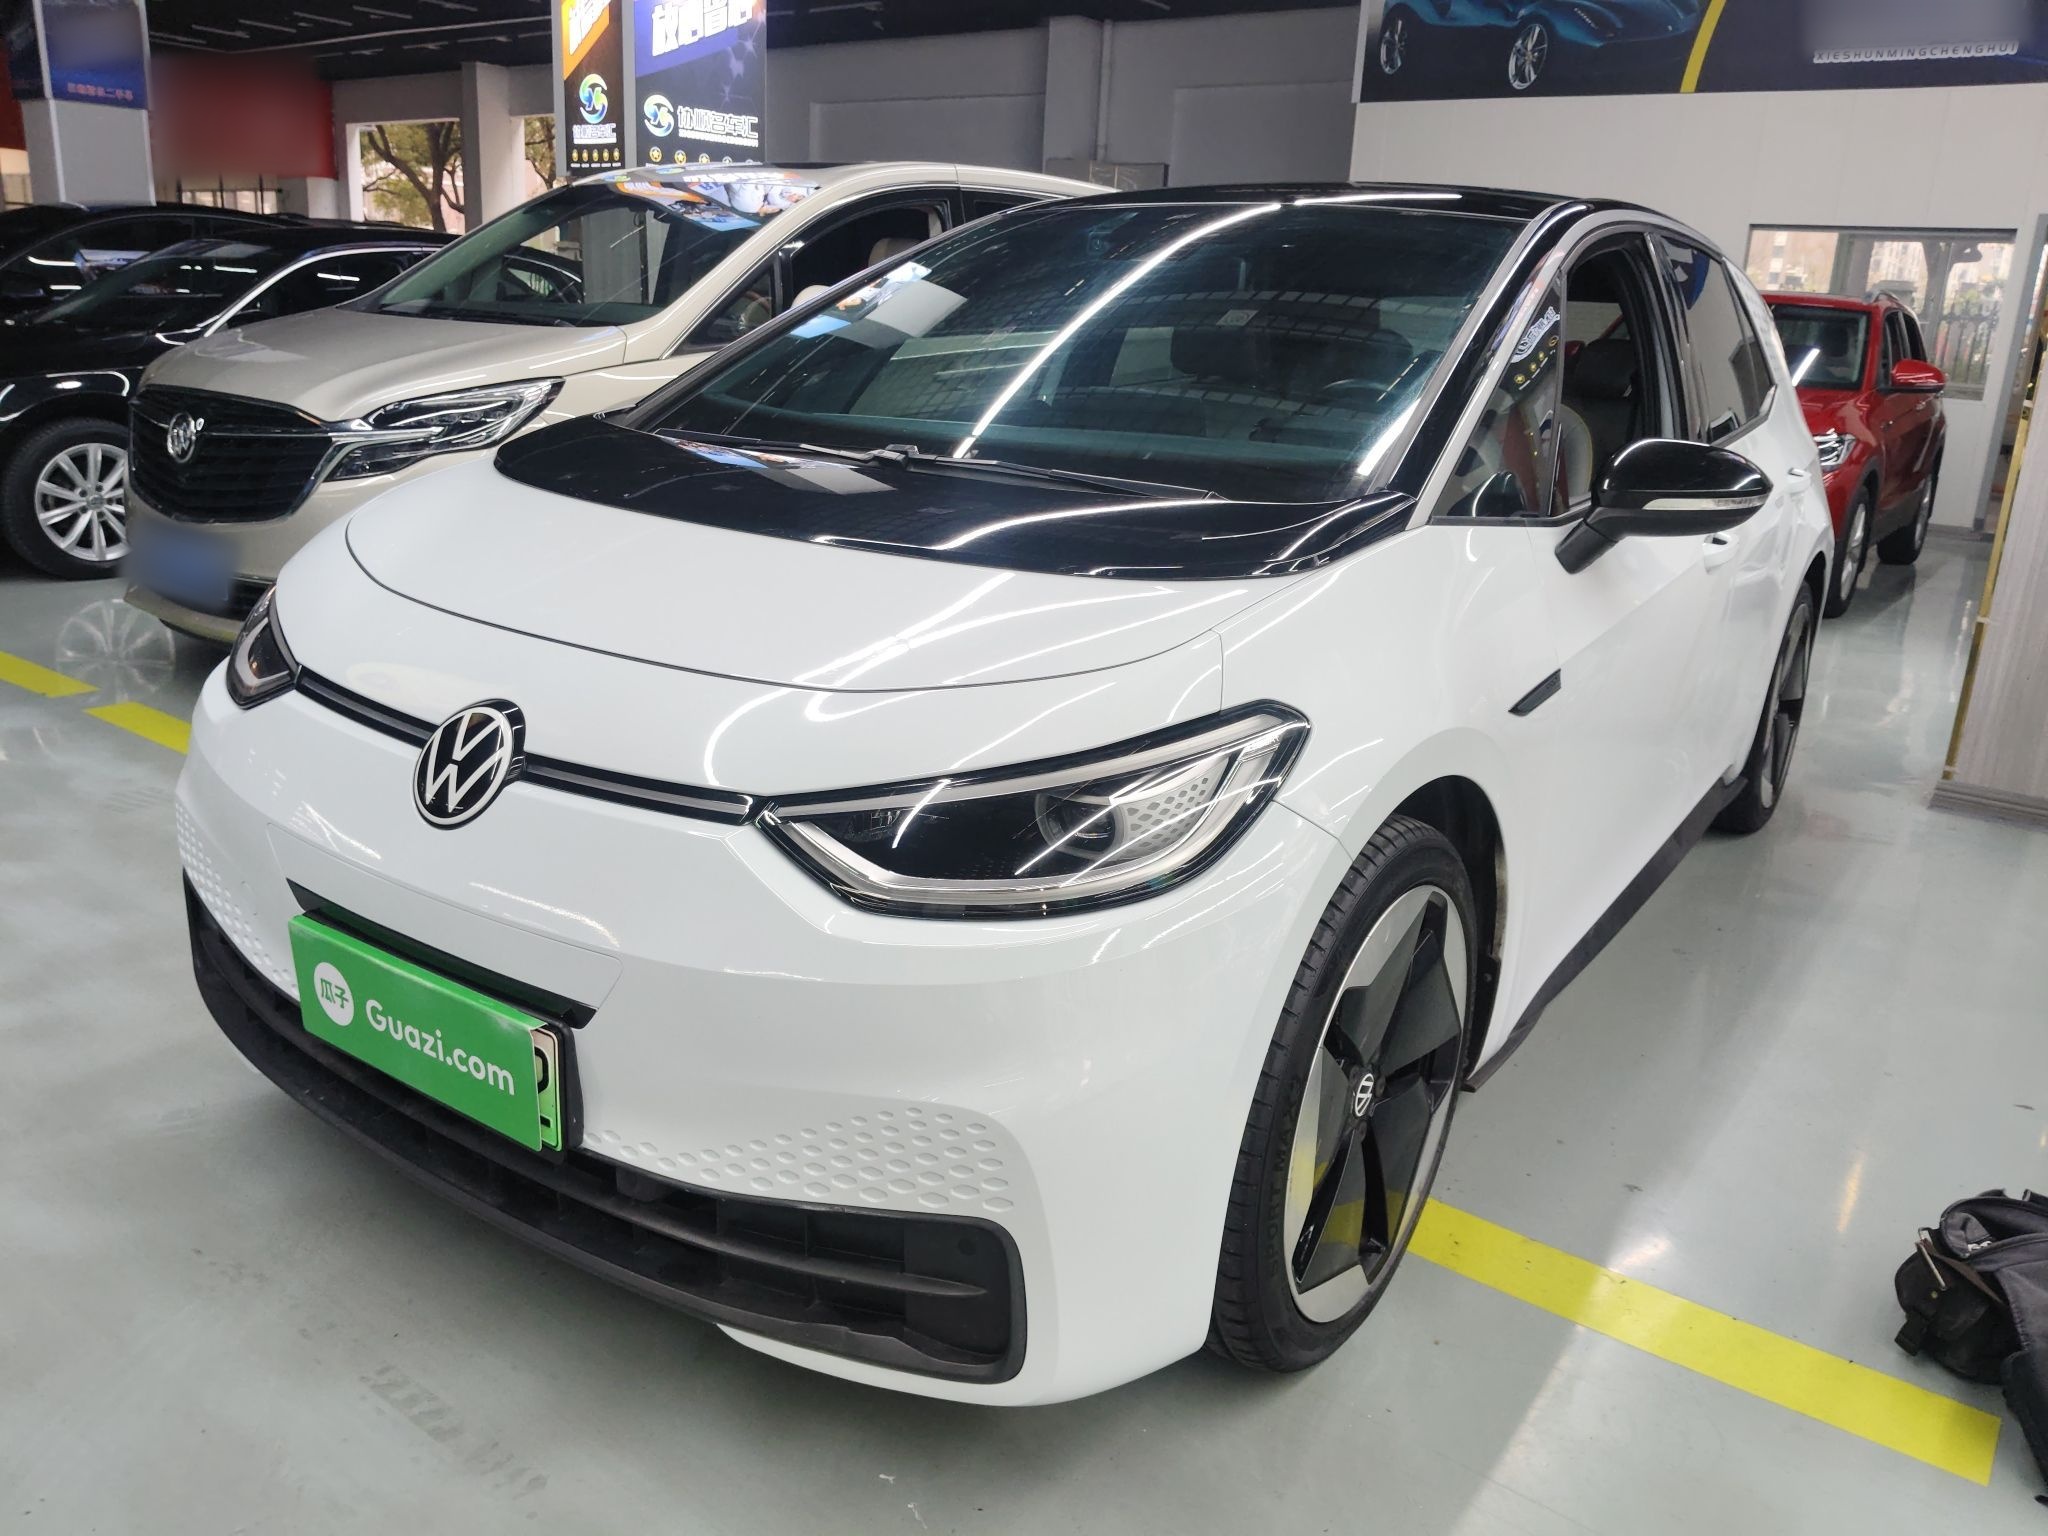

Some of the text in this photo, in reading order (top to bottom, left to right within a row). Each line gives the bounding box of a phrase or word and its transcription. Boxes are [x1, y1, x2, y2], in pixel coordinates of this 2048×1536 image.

[1815, 42, 2018, 62] XIESHUNMINGCHENGHUI
[319, 977, 349, 1009] 瓜子
[365, 999, 516, 1096] Guazi.com
